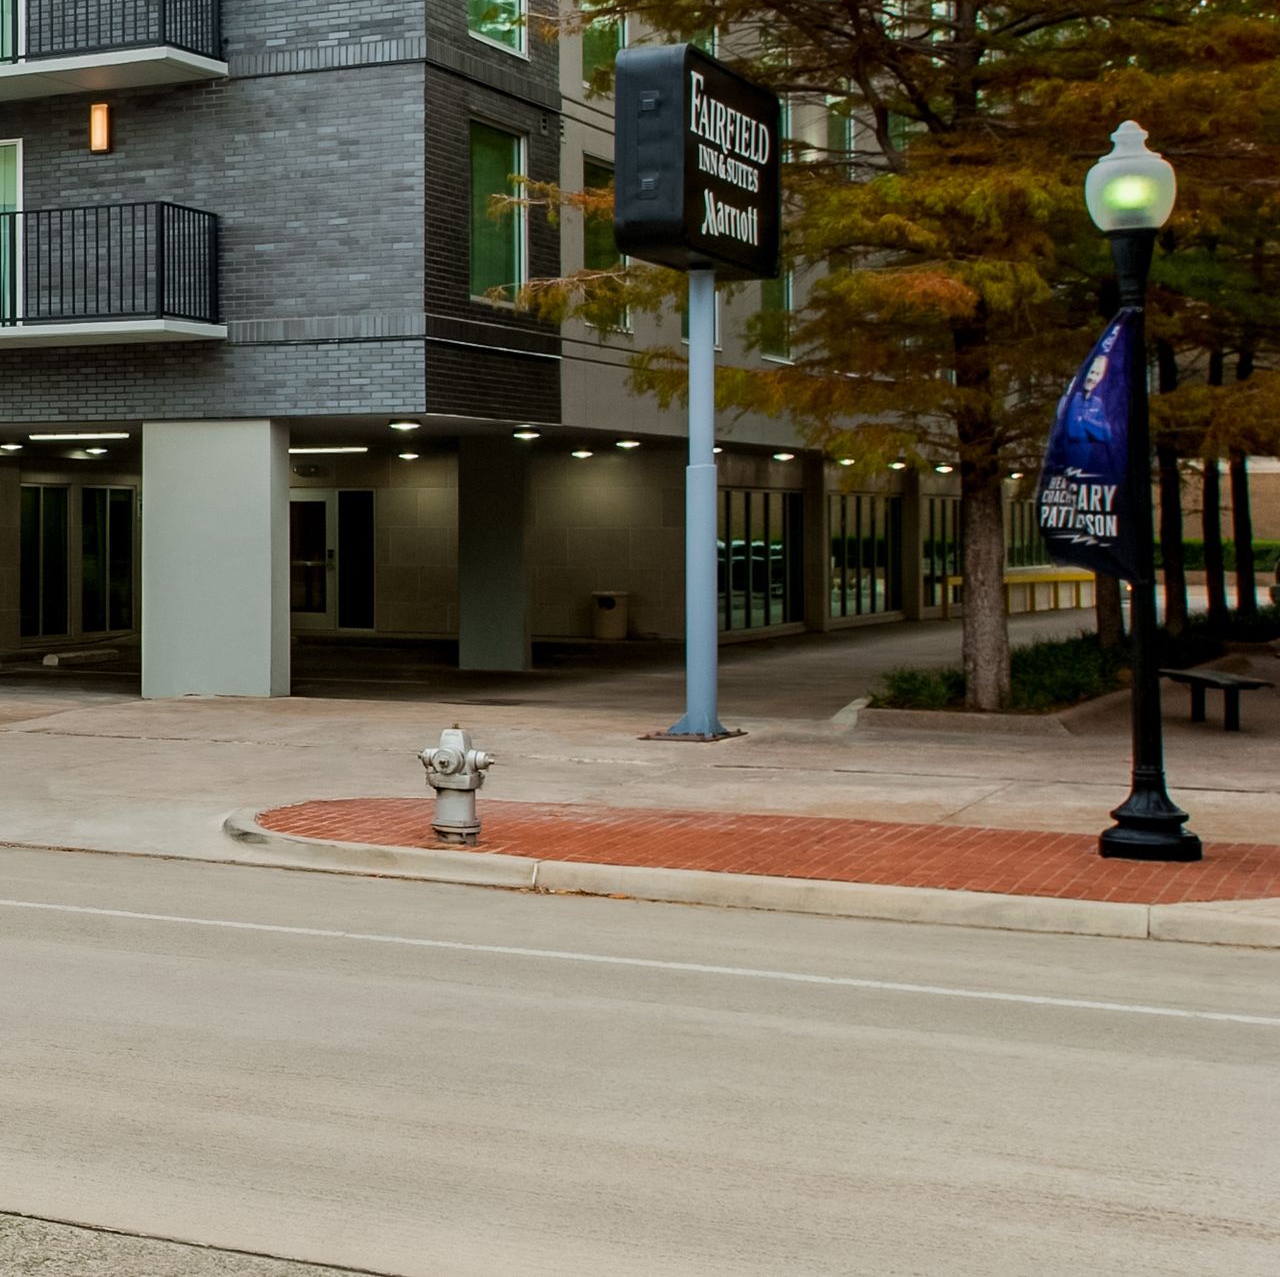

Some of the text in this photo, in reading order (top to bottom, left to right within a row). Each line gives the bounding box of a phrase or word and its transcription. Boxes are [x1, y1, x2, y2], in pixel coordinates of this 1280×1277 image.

[690, 70, 770, 165] FAIRFIELD
[698, 143, 759, 194] INN & SUITES
[701, 188, 759, 246] Marriott
[1048, 475, 1067, 490] HEA
[1069, 483, 1117, 512] GARY
